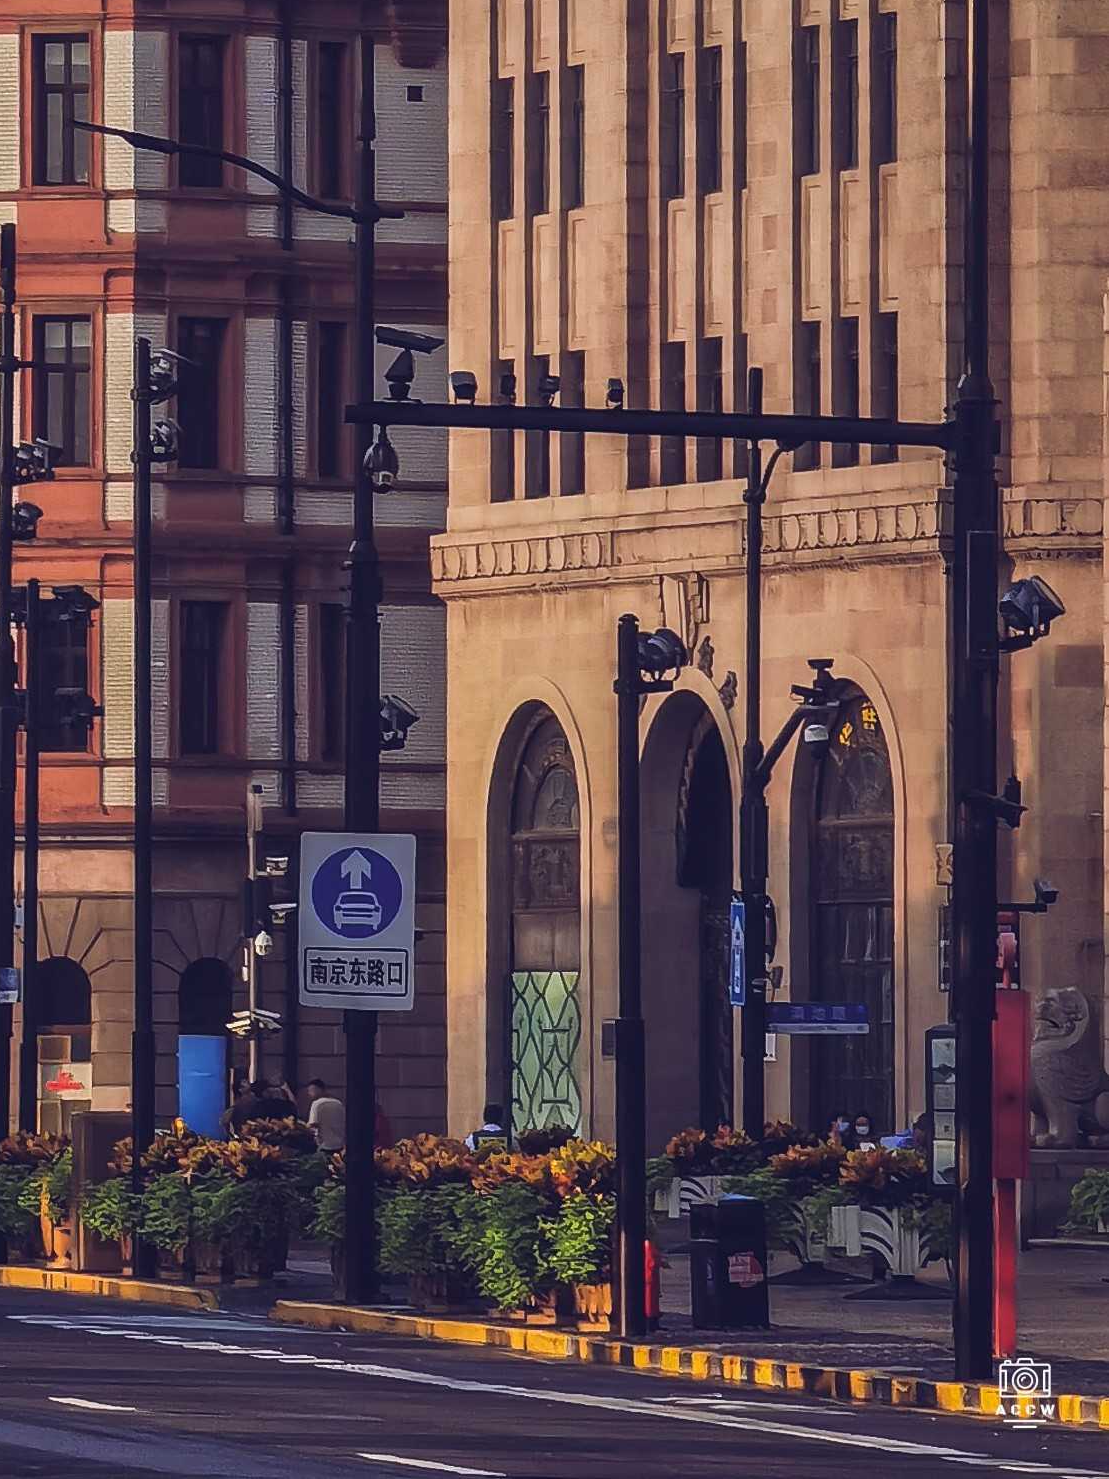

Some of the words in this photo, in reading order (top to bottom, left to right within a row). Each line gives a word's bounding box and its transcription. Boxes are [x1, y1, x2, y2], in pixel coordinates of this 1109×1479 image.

[309, 956, 403, 987] 南京东路口
